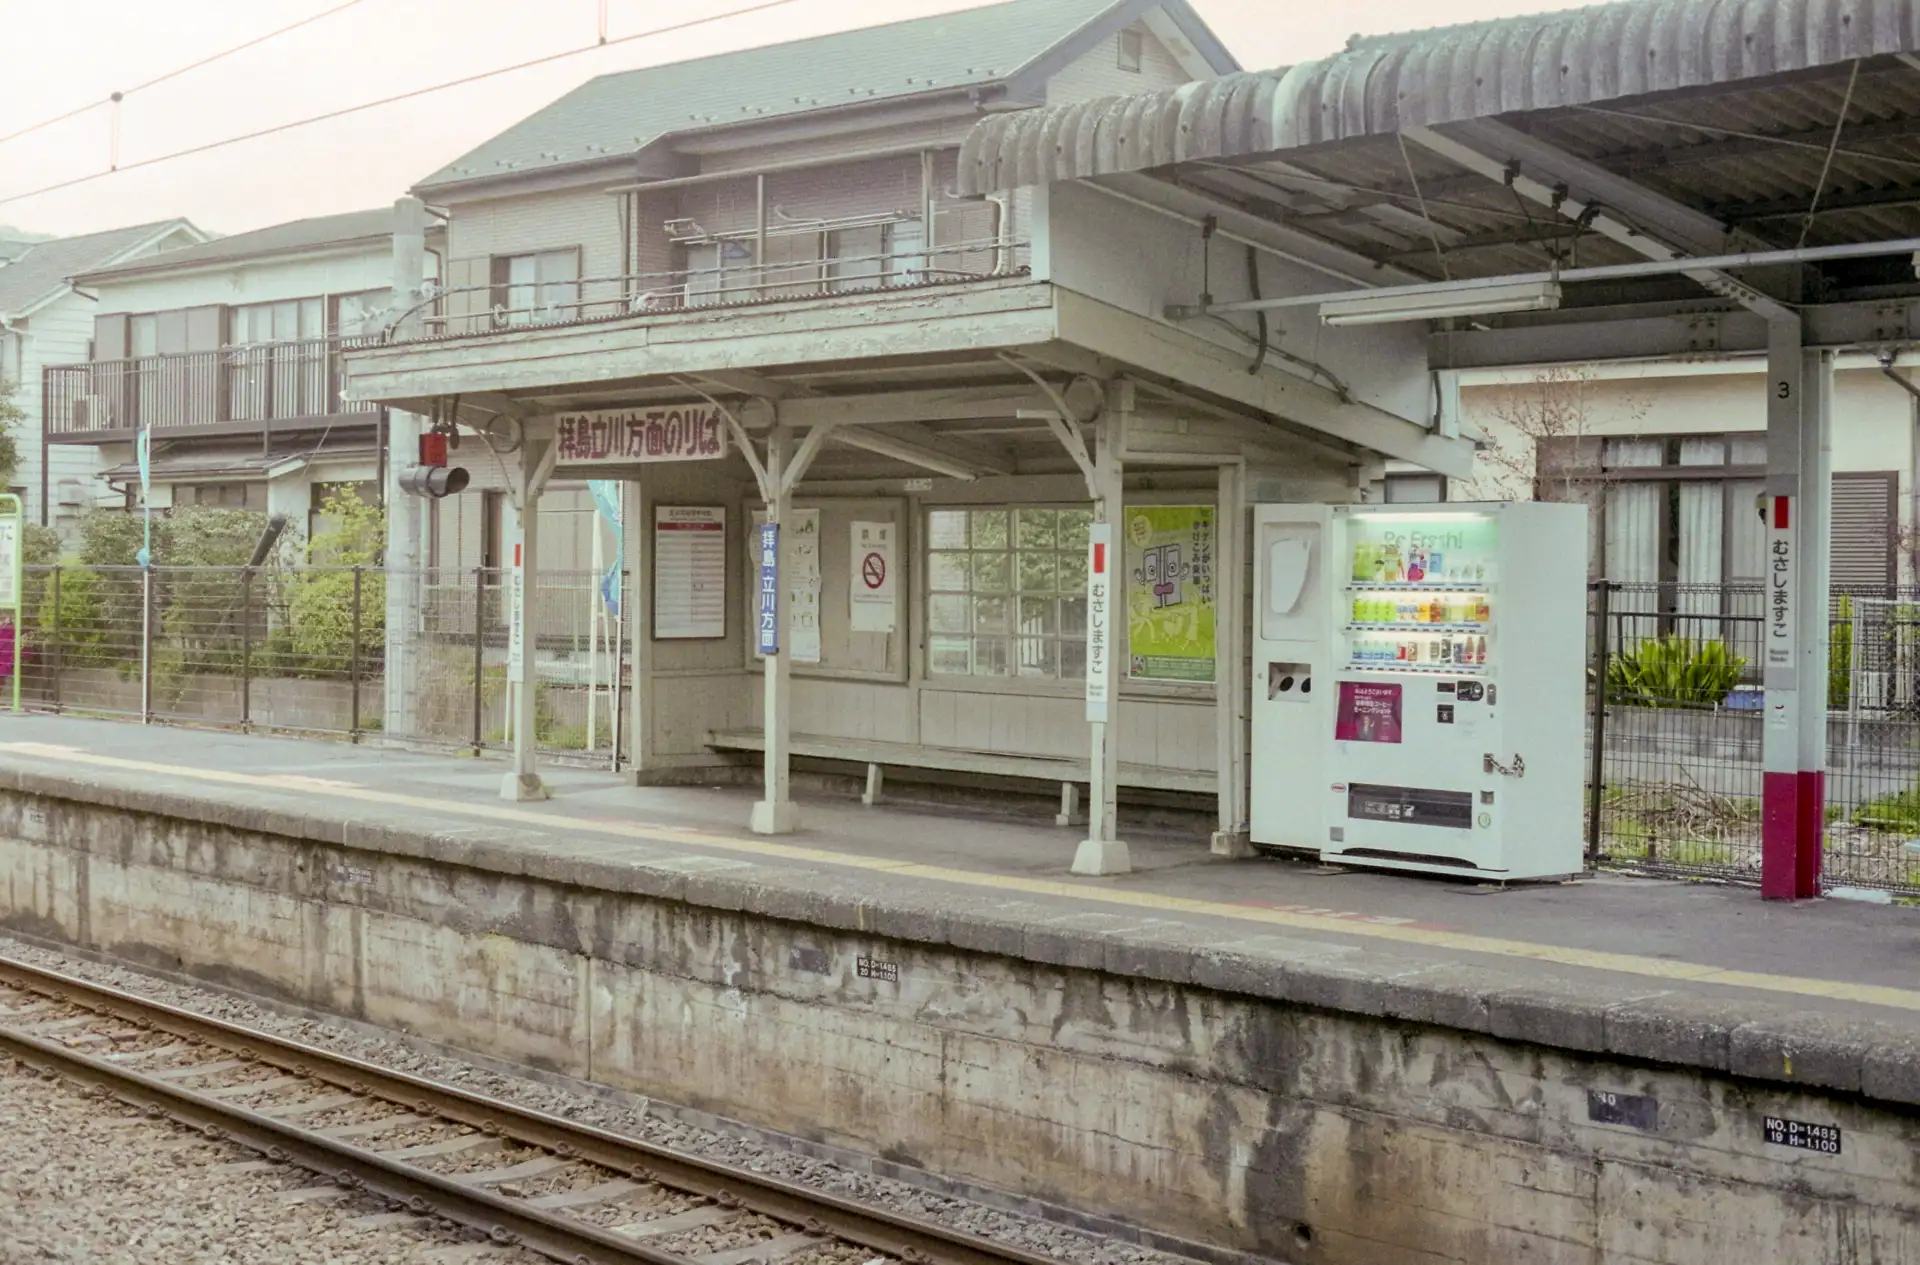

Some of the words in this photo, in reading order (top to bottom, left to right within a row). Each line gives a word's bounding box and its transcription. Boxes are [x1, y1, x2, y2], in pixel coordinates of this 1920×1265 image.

[1777, 382, 1790, 399] 3
[558, 410, 721, 459] 拝島立川方面のりば
[761, 531, 775, 647] 拝島・立川方面
[1773, 540, 1788, 637] むさしますこ
[1091, 584, 1105, 674] むさしますこ
[1766, 1118, 1787, 1132] NO.
[1771, 1131, 1784, 1142] 19
